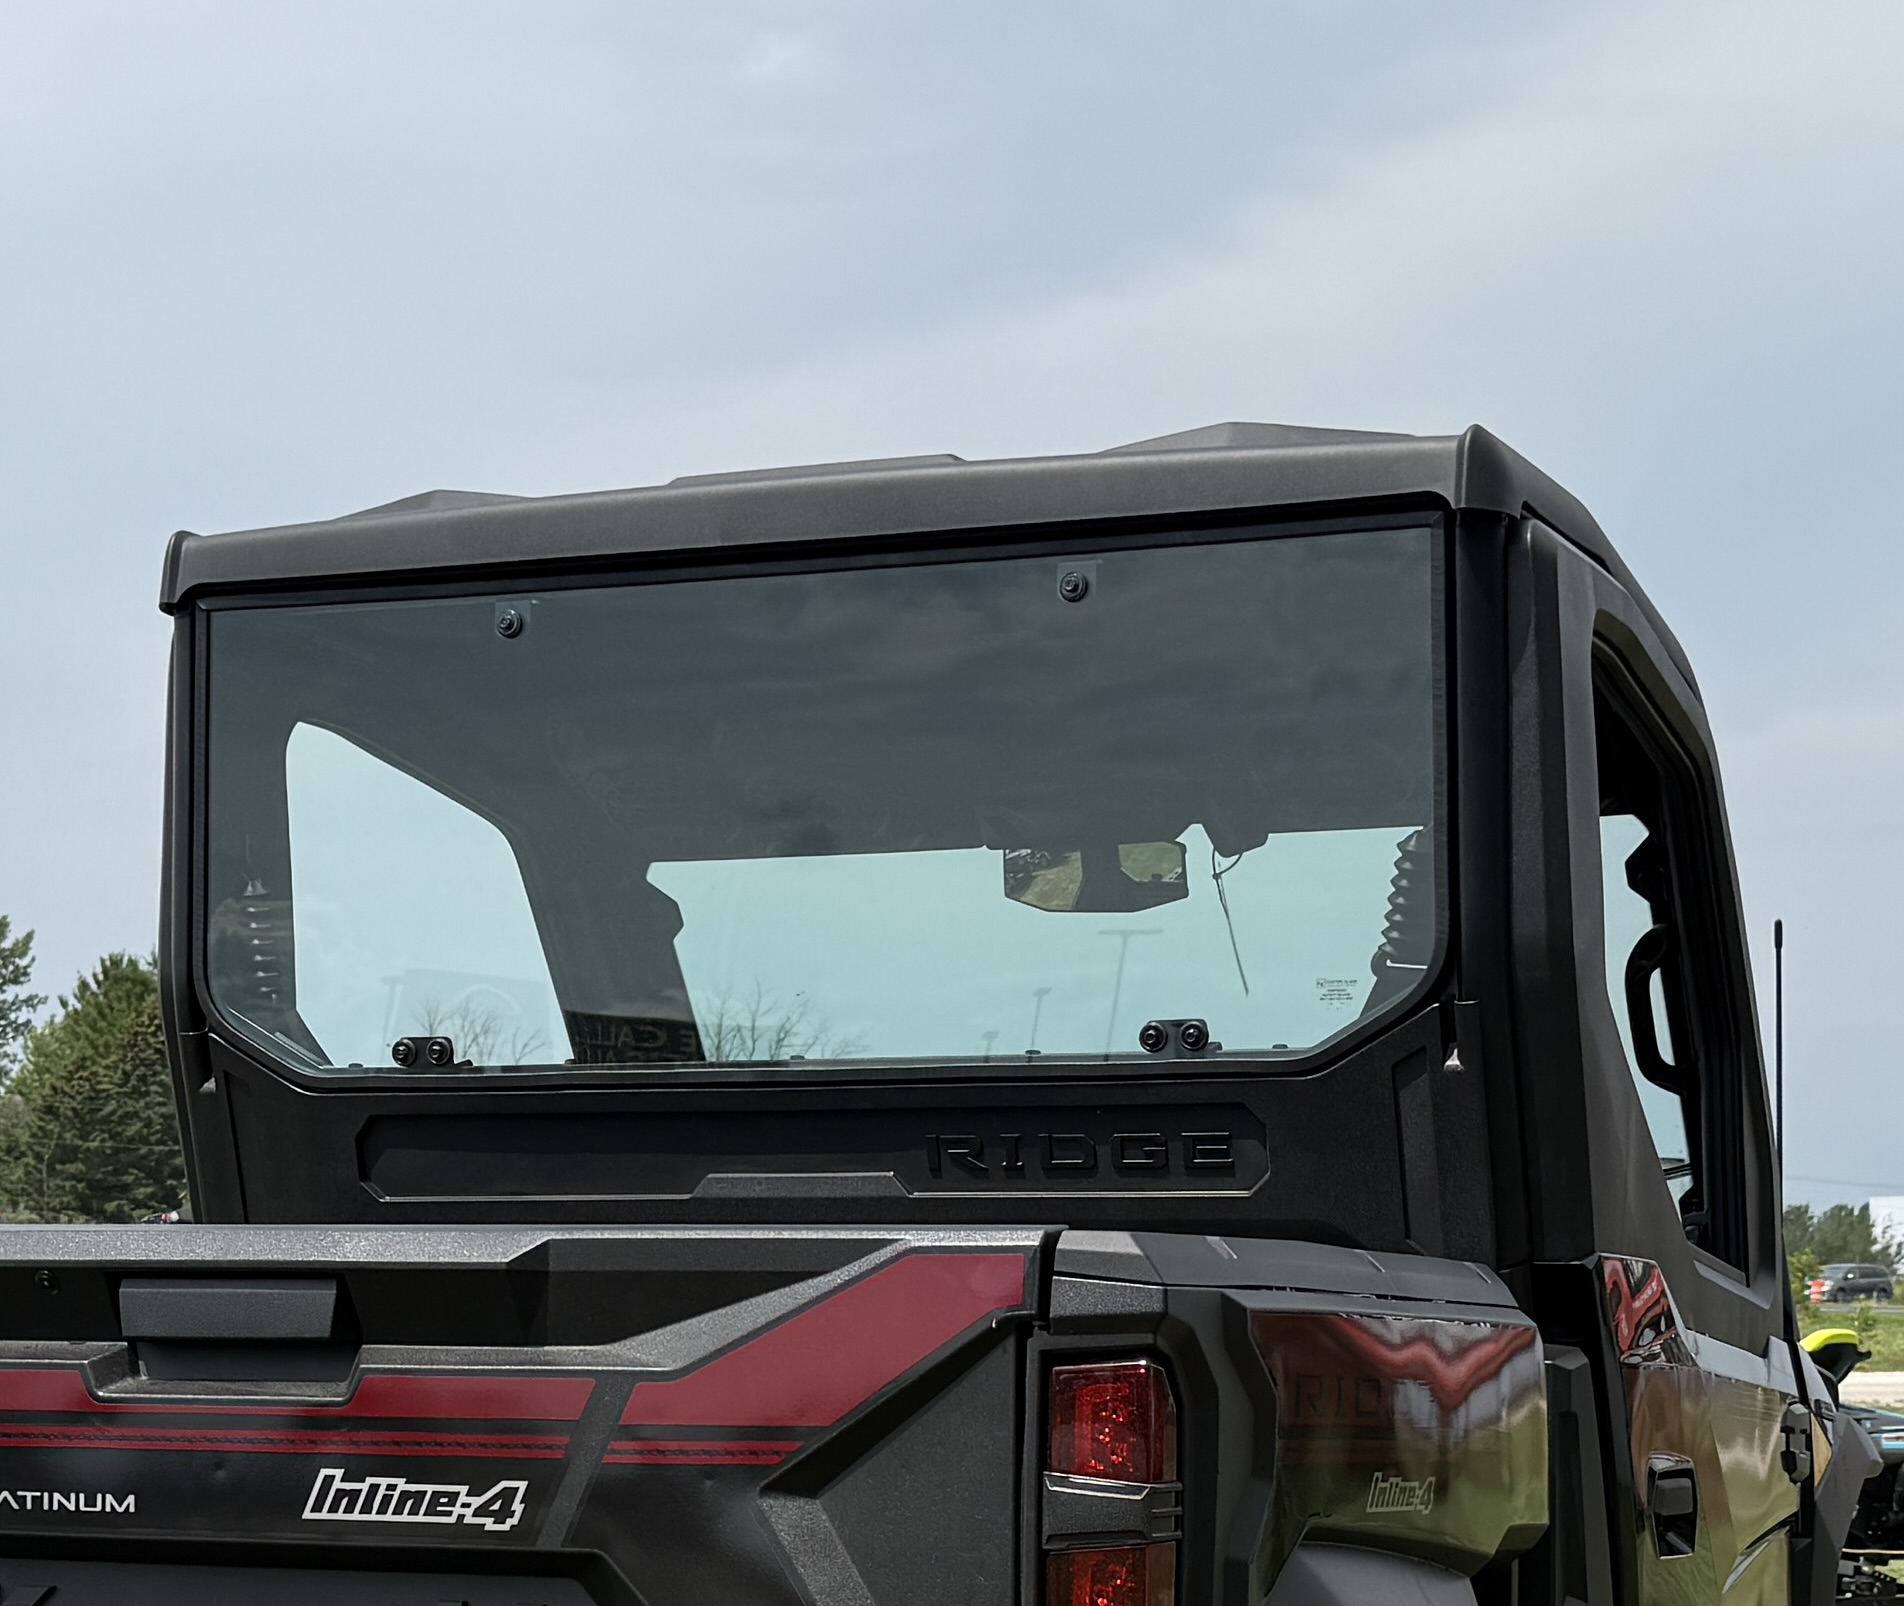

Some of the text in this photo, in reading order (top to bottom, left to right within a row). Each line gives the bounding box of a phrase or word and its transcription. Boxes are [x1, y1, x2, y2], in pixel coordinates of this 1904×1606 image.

[925, 1131, 1235, 1172] RIDGE
[302, 1468, 529, 1532] Inline-4
[1365, 1470, 1436, 1515] Inline-4
